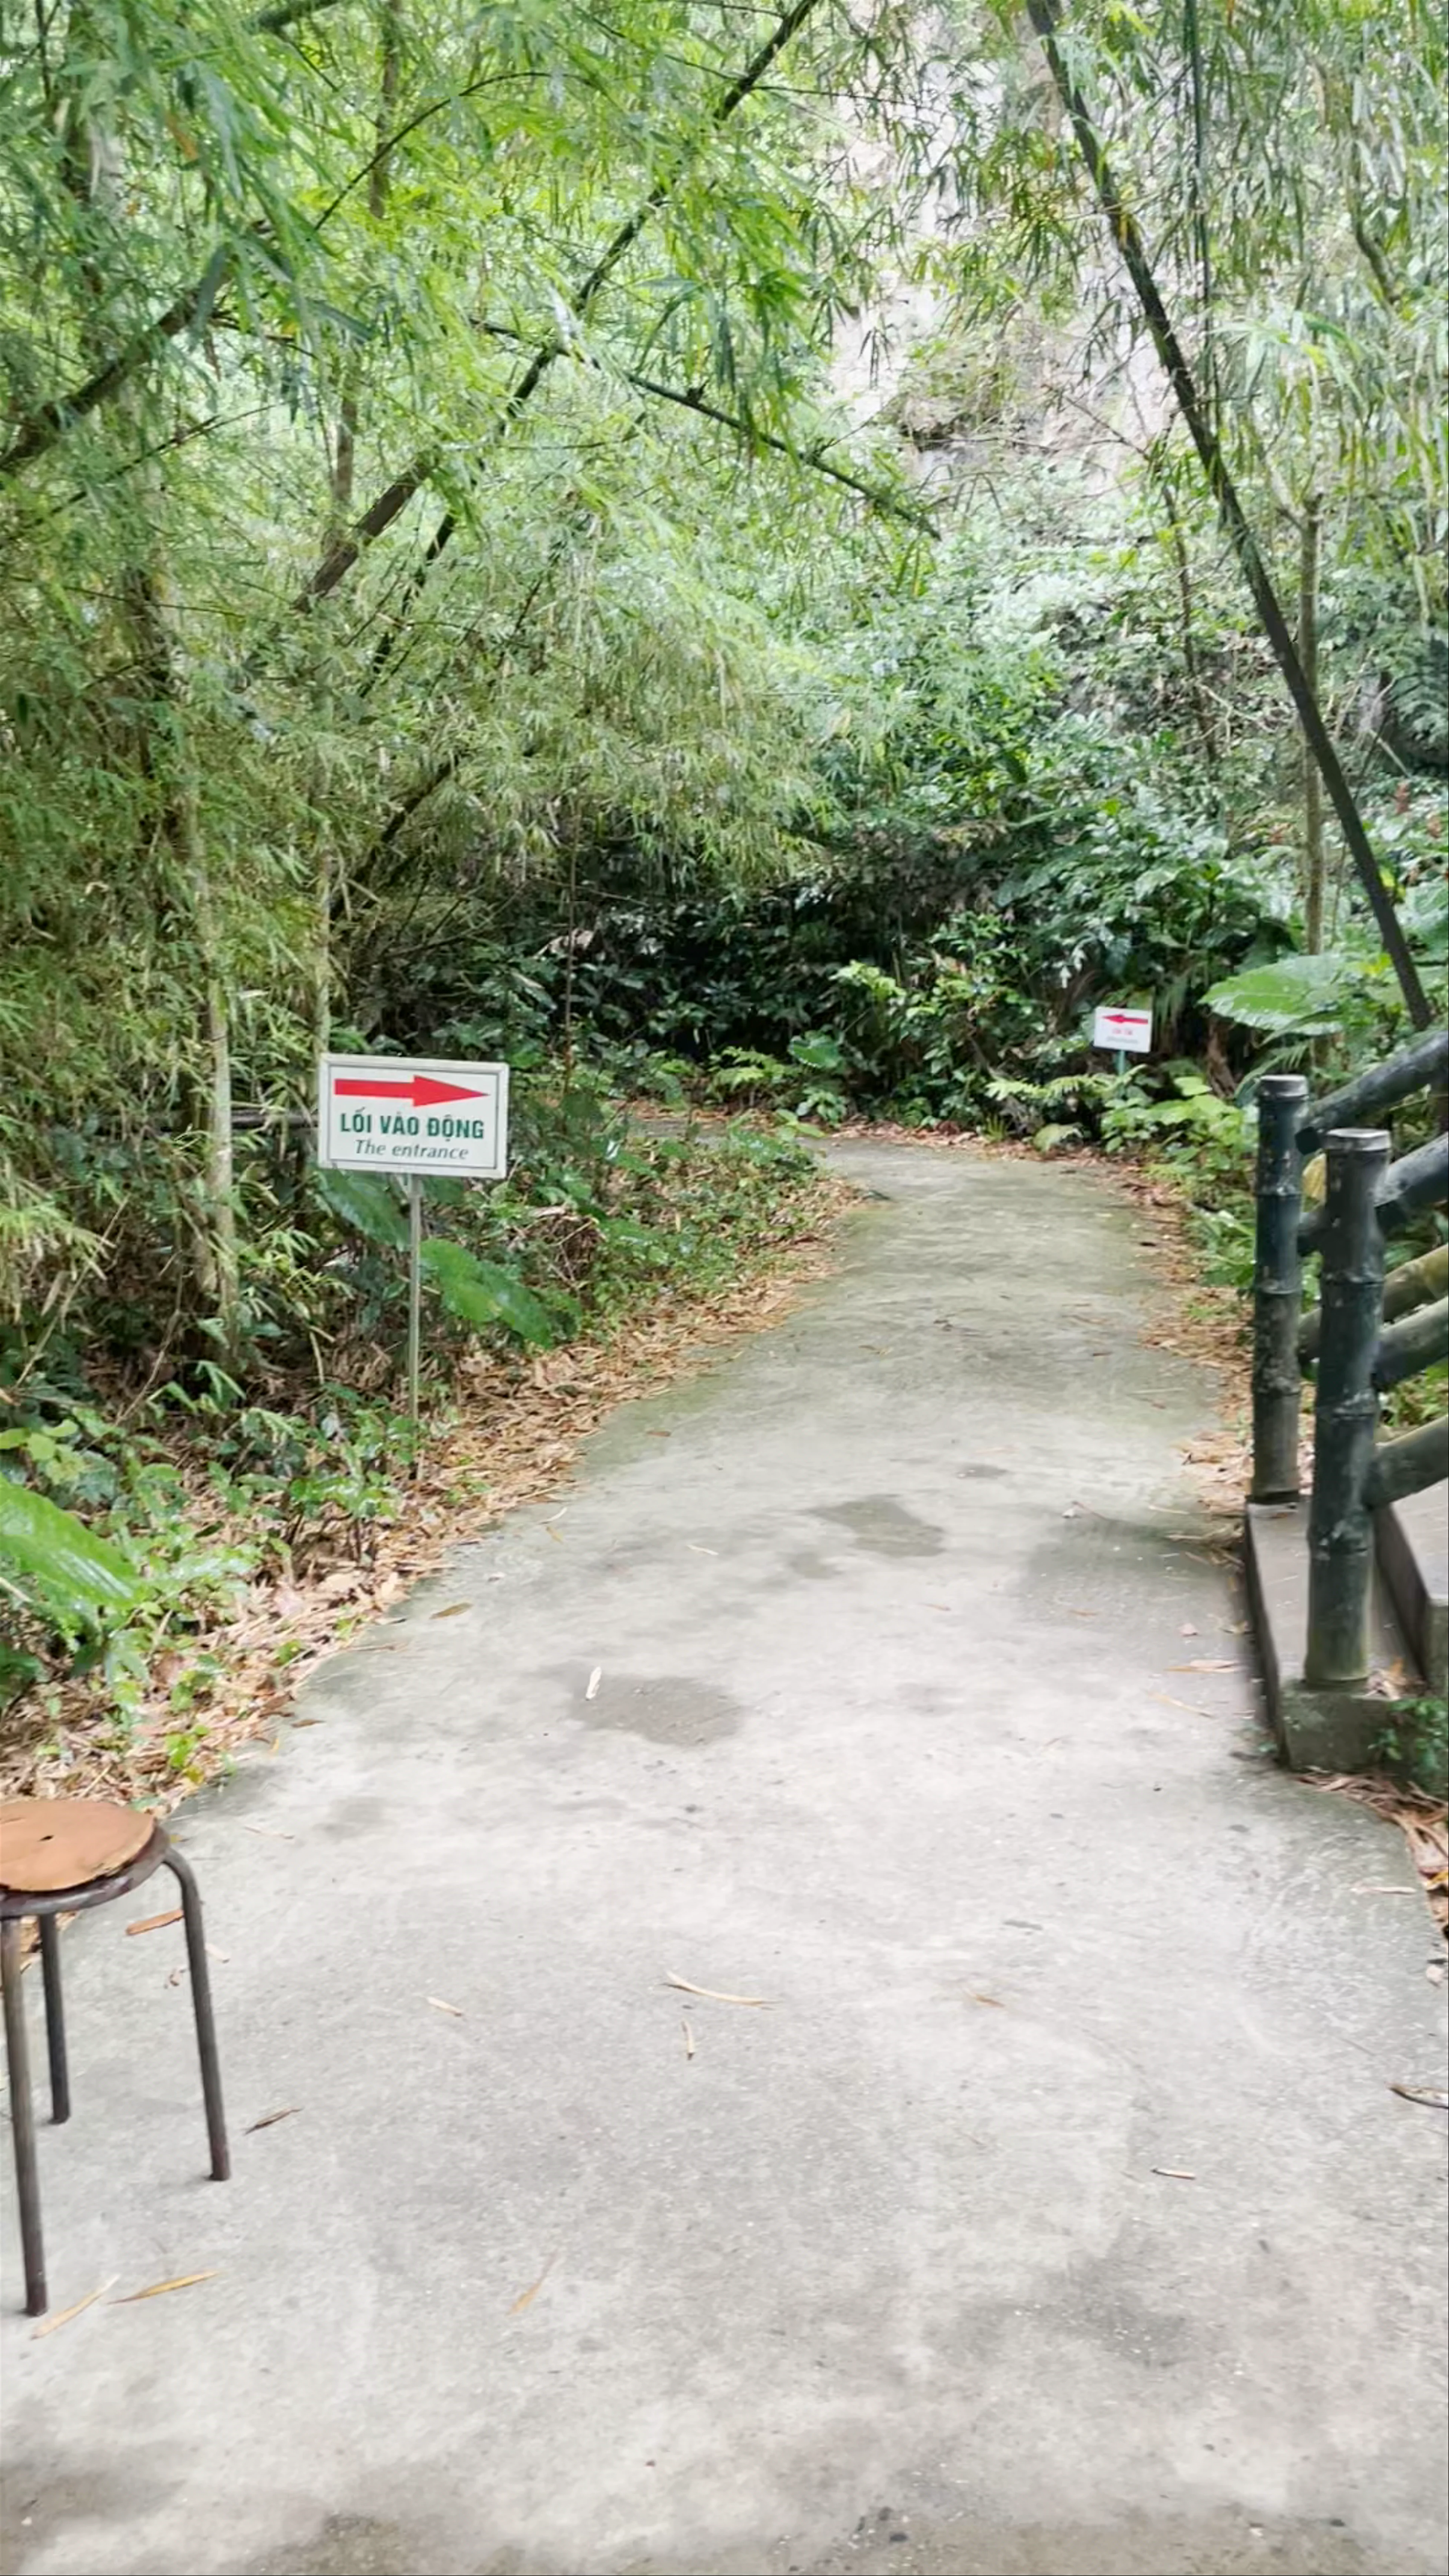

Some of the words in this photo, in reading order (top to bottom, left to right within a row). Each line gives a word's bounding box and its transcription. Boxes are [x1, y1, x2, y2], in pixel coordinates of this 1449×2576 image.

[341, 1106, 372, 1133] LỐI
[380, 1111, 419, 1136] VÀO
[427, 1114, 484, 1142] ĐỘNG
[355, 1139, 386, 1155] The
[392, 1144, 469, 1160] entrance
